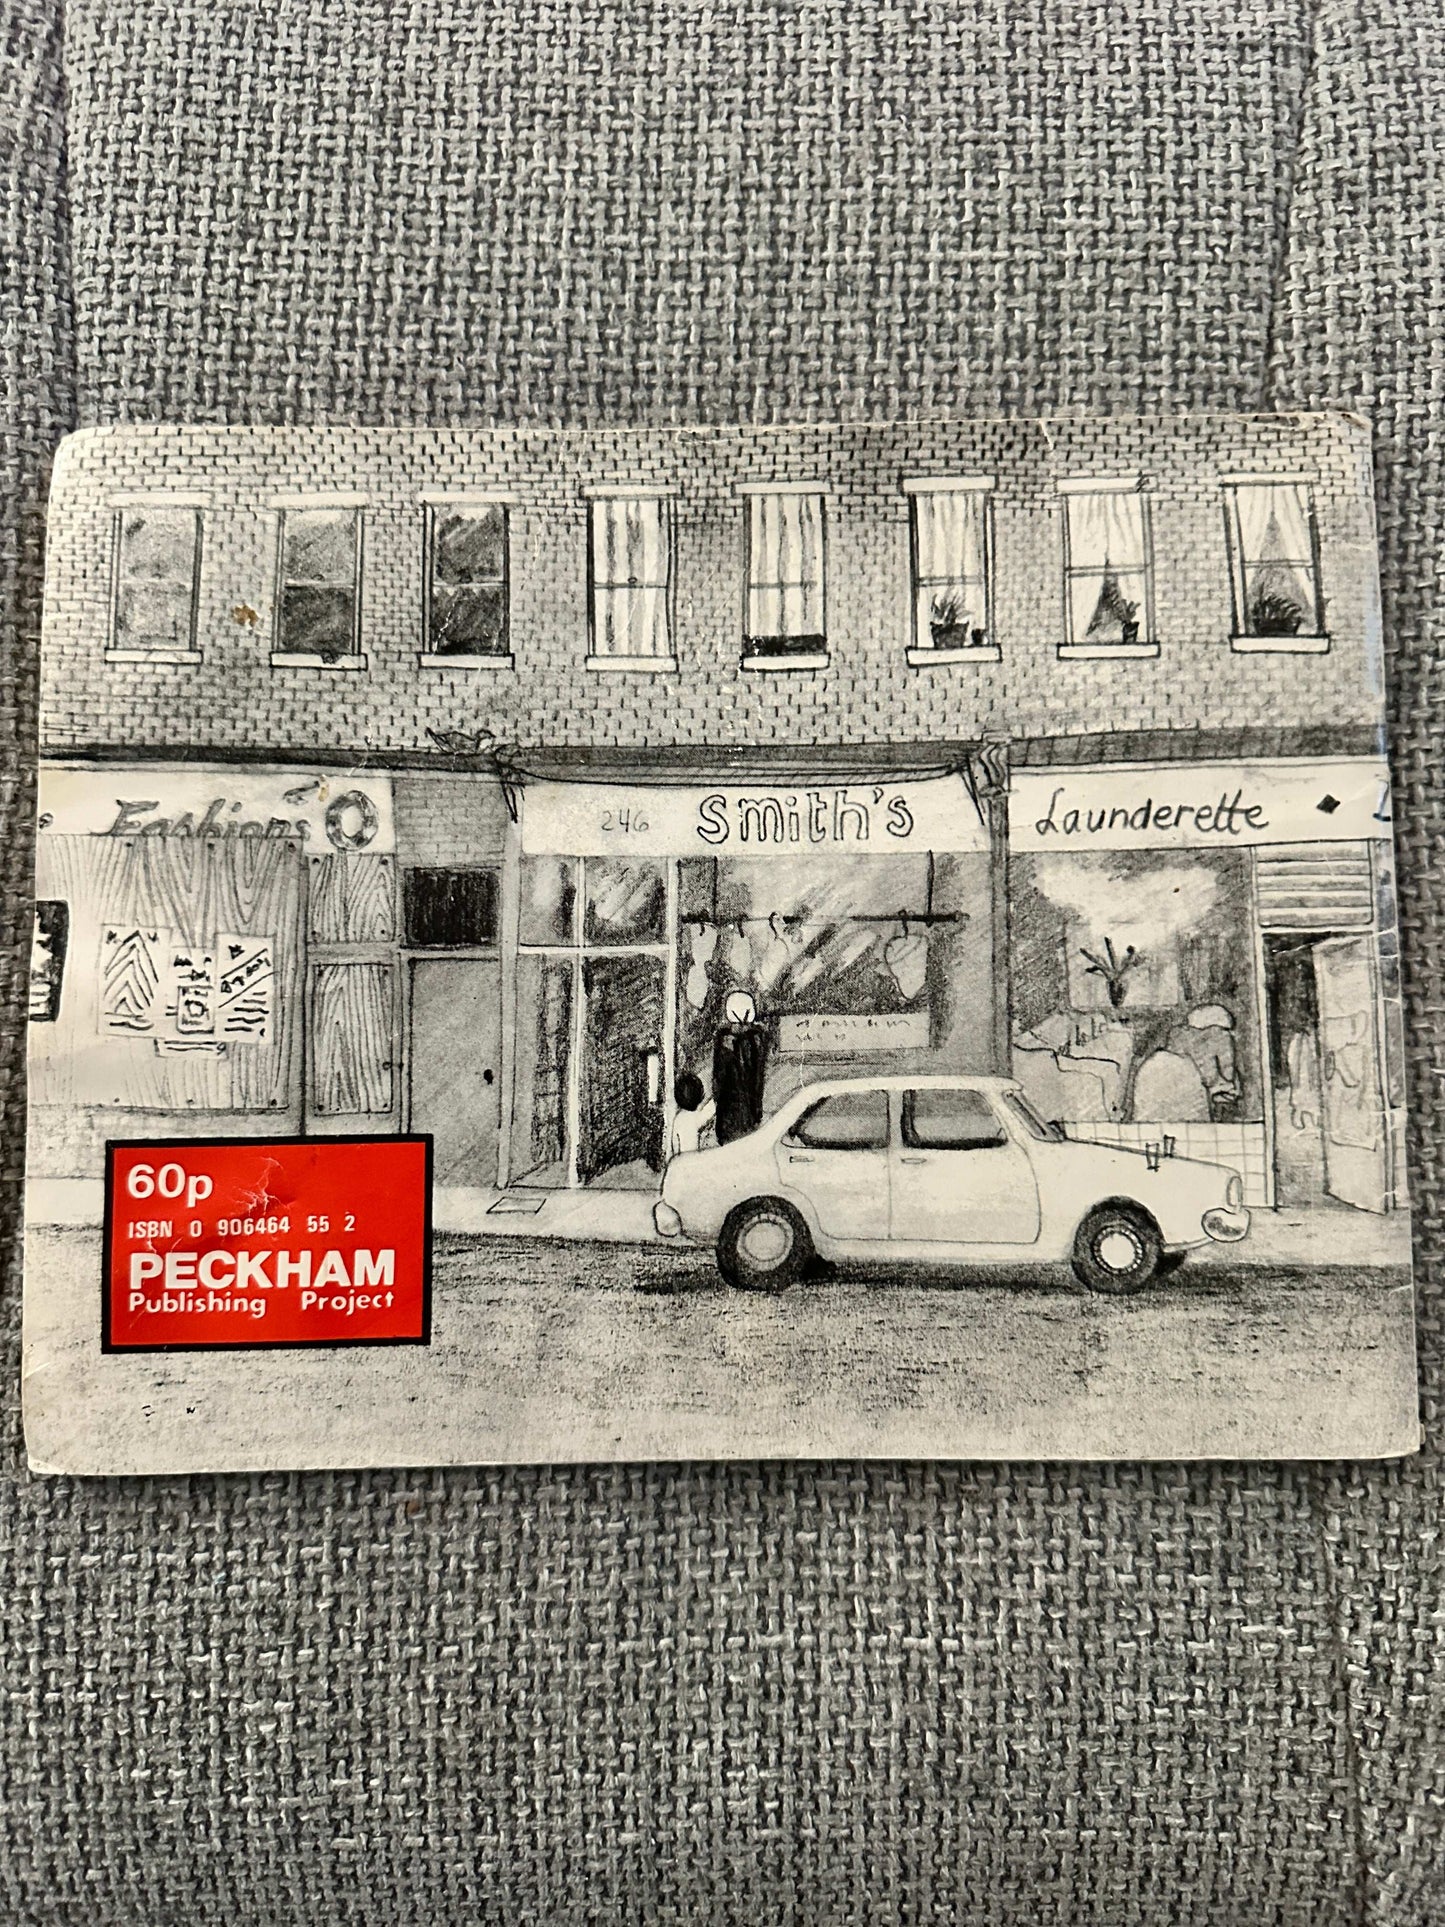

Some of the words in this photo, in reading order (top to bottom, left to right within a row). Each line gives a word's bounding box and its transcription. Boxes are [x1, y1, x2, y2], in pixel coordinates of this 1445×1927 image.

[601, 809, 649, 832] 246
[697, 787, 914, 844] Smith's
[1036, 788, 1269, 834] Launderette
[127, 1163, 213, 1207] 60p
[128, 1222, 173, 1239] ISBN
[190, 1221, 203, 1237] 0
[218, 1217, 290, 1236] 906464
[308, 1215, 330, 1232] 55
[344, 1215, 356, 1232] 2
[130, 1250, 395, 1290] PECKHAM
[129, 1292, 266, 1319] Publishing
[301, 1290, 394, 1315] Project
